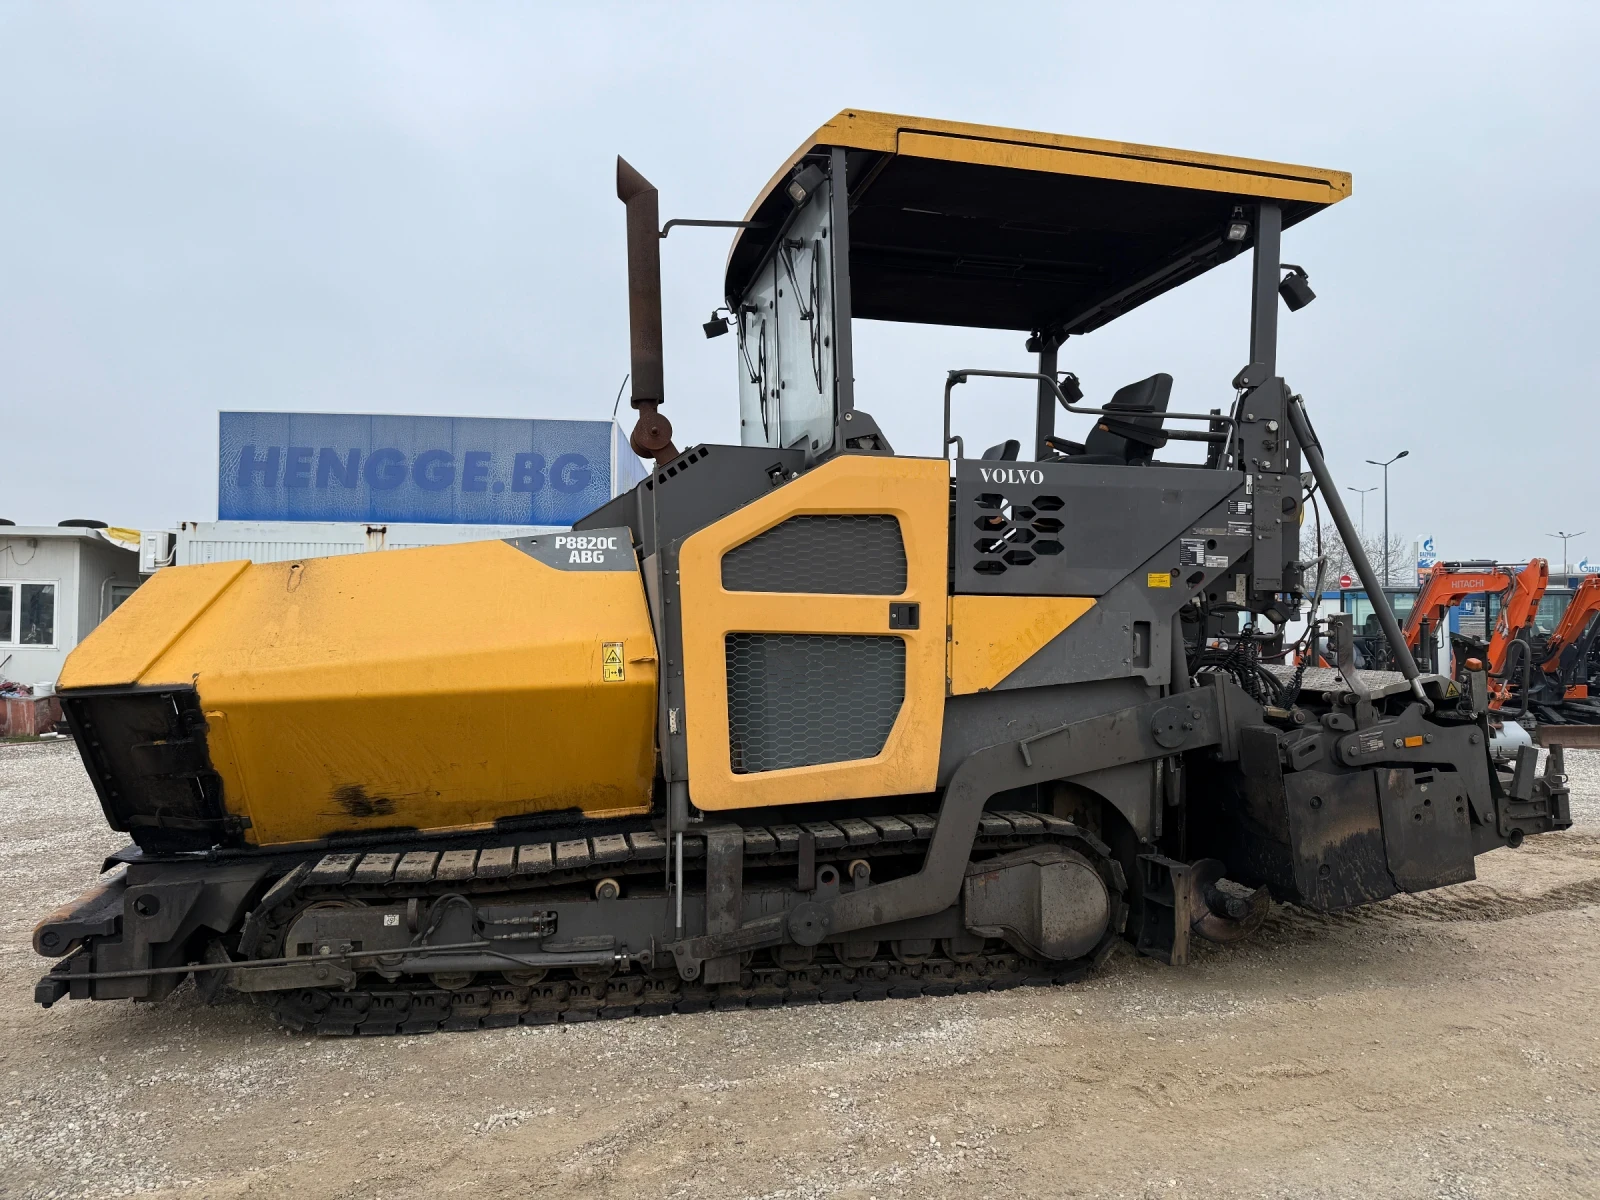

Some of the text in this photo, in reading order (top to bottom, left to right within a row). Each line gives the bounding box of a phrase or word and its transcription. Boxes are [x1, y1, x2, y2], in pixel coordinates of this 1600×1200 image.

[237, 445, 592, 494] HENGGE.BG
[979, 467, 1044, 485] VOLVO
[555, 536, 618, 550] P8820C
[568, 550, 605, 564] ABG
[1451, 579, 1485, 589] HITACHI
